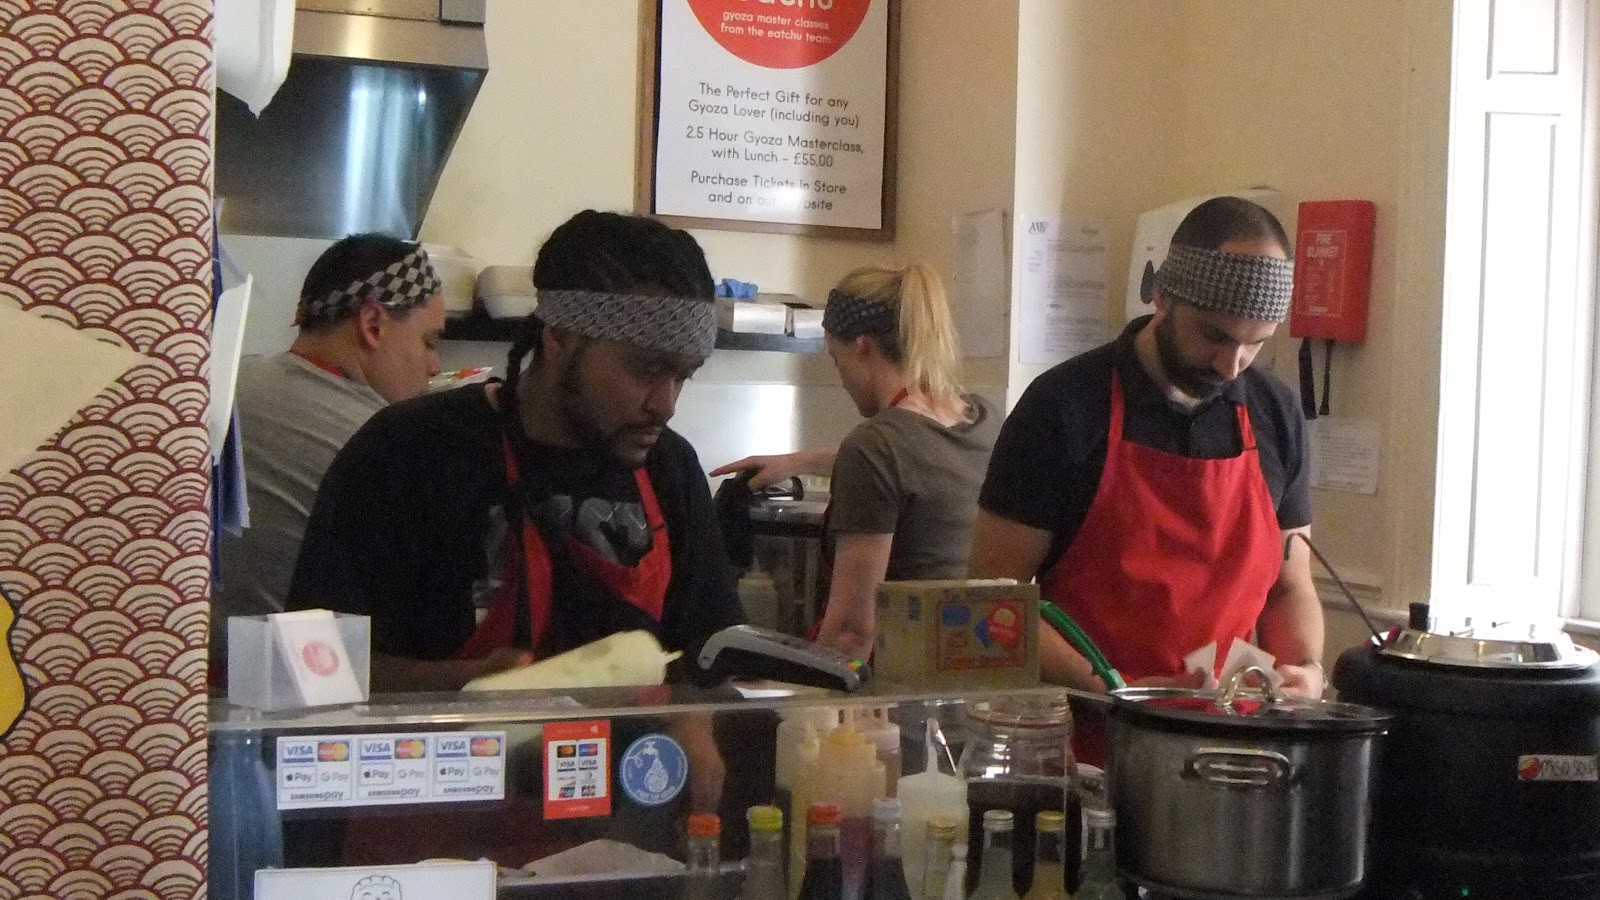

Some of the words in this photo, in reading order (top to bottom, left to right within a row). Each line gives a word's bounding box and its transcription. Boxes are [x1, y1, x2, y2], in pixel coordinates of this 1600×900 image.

[723, 12, 754, 22] gyoza
[757, 14, 792, 26] master
[795, 17, 829, 30] classes
[720, 24, 744, 35] from
[747, 25, 764, 37] the
[768, 28, 802, 41] eatchu
[806, 33, 831, 44] team
[700, 83, 721, 97] The
[727, 85, 770, 101] Perfect
[775, 90, 800, 104] Gift
[805, 93, 823, 106] for
[827, 99, 849, 111] any
[688, 100, 729, 116] Gyoza
[733, 104, 766, 118] Lover
[770, 108, 830, 126] (including
[834, 115, 860, 128] you)
[686, 125, 704, 139] 2.5
[709, 128, 738, 142] Hour
[744, 131, 783, 147] Gyoza
[788, 135, 864, 154] Masterclass,
[712, 148, 740, 160] with
[745, 149, 778, 163] Lunch
[794, 153, 833, 168] £55.00
[691, 170, 748, 187] Purchase
[814, 180, 847, 195] Store
[708, 192, 732, 204] and
[738, 195, 752, 205] on
[287, 745, 313, 755] VISA
[365, 743, 391, 753] VISA
[441, 741, 466, 750] VISA
[295, 772, 312, 782] Pay
[332, 772, 349, 782] Pay
[372, 769, 389, 779] Pay
[447, 766, 464, 776] Pay
